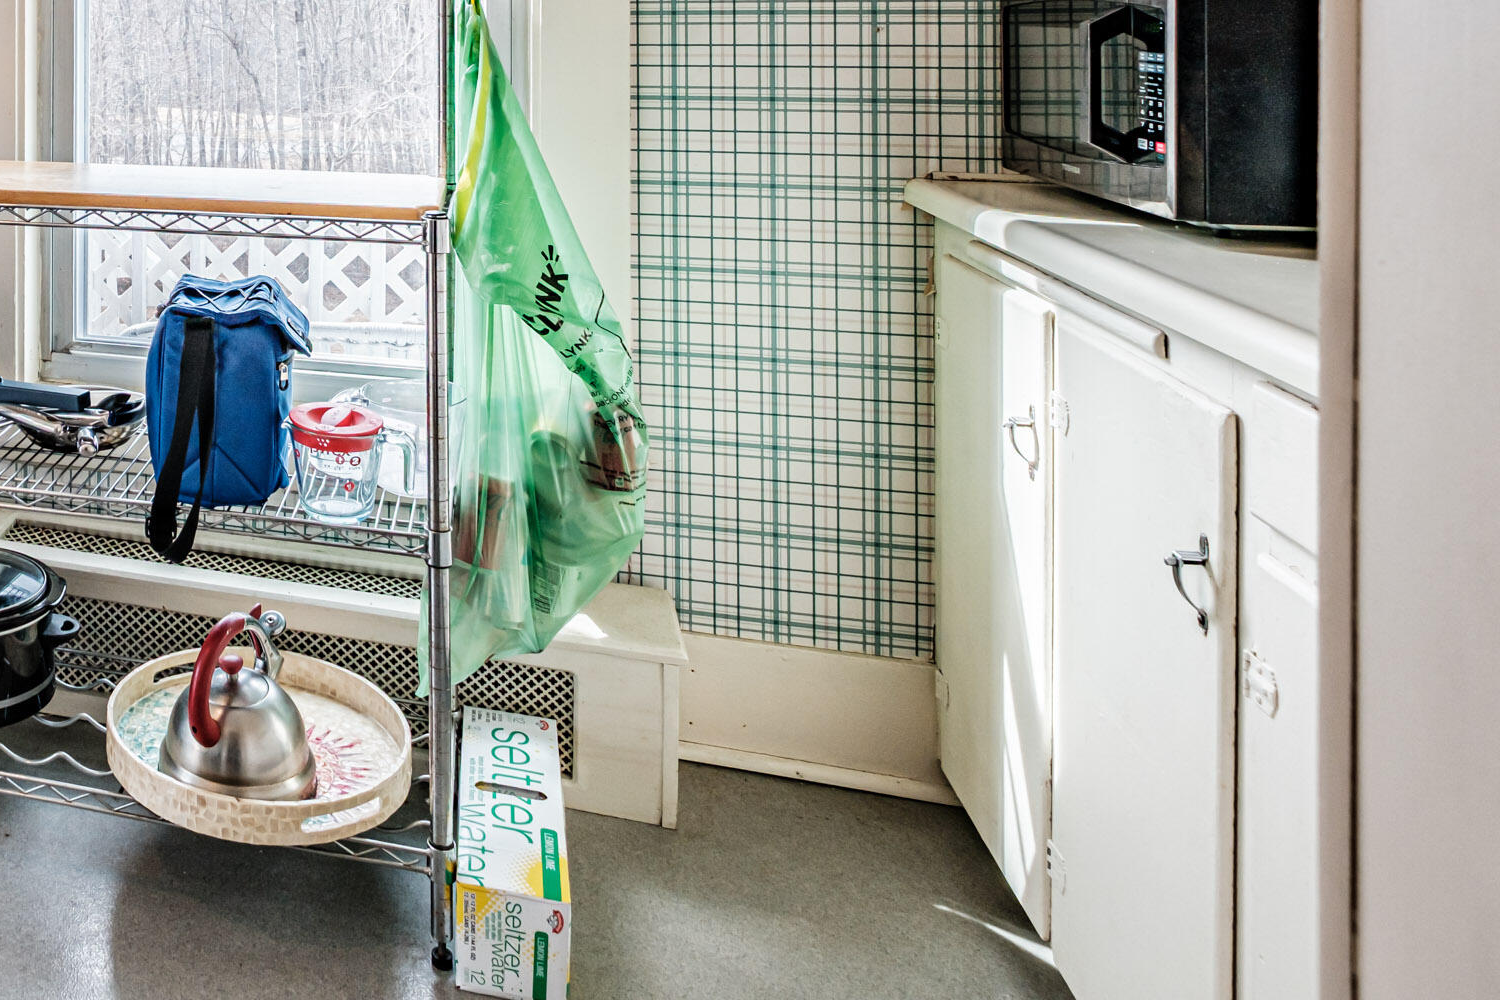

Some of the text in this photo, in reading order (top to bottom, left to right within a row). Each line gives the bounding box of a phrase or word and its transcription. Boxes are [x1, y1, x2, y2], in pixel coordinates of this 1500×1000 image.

[457, 804, 494, 887] water
[544, 832, 556, 871] LEMON LIME
[504, 901, 526, 978] seltzer
[535, 937, 545, 978] LEMON LIME
[470, 969, 486, 986] 12
[491, 943, 506, 993] water
